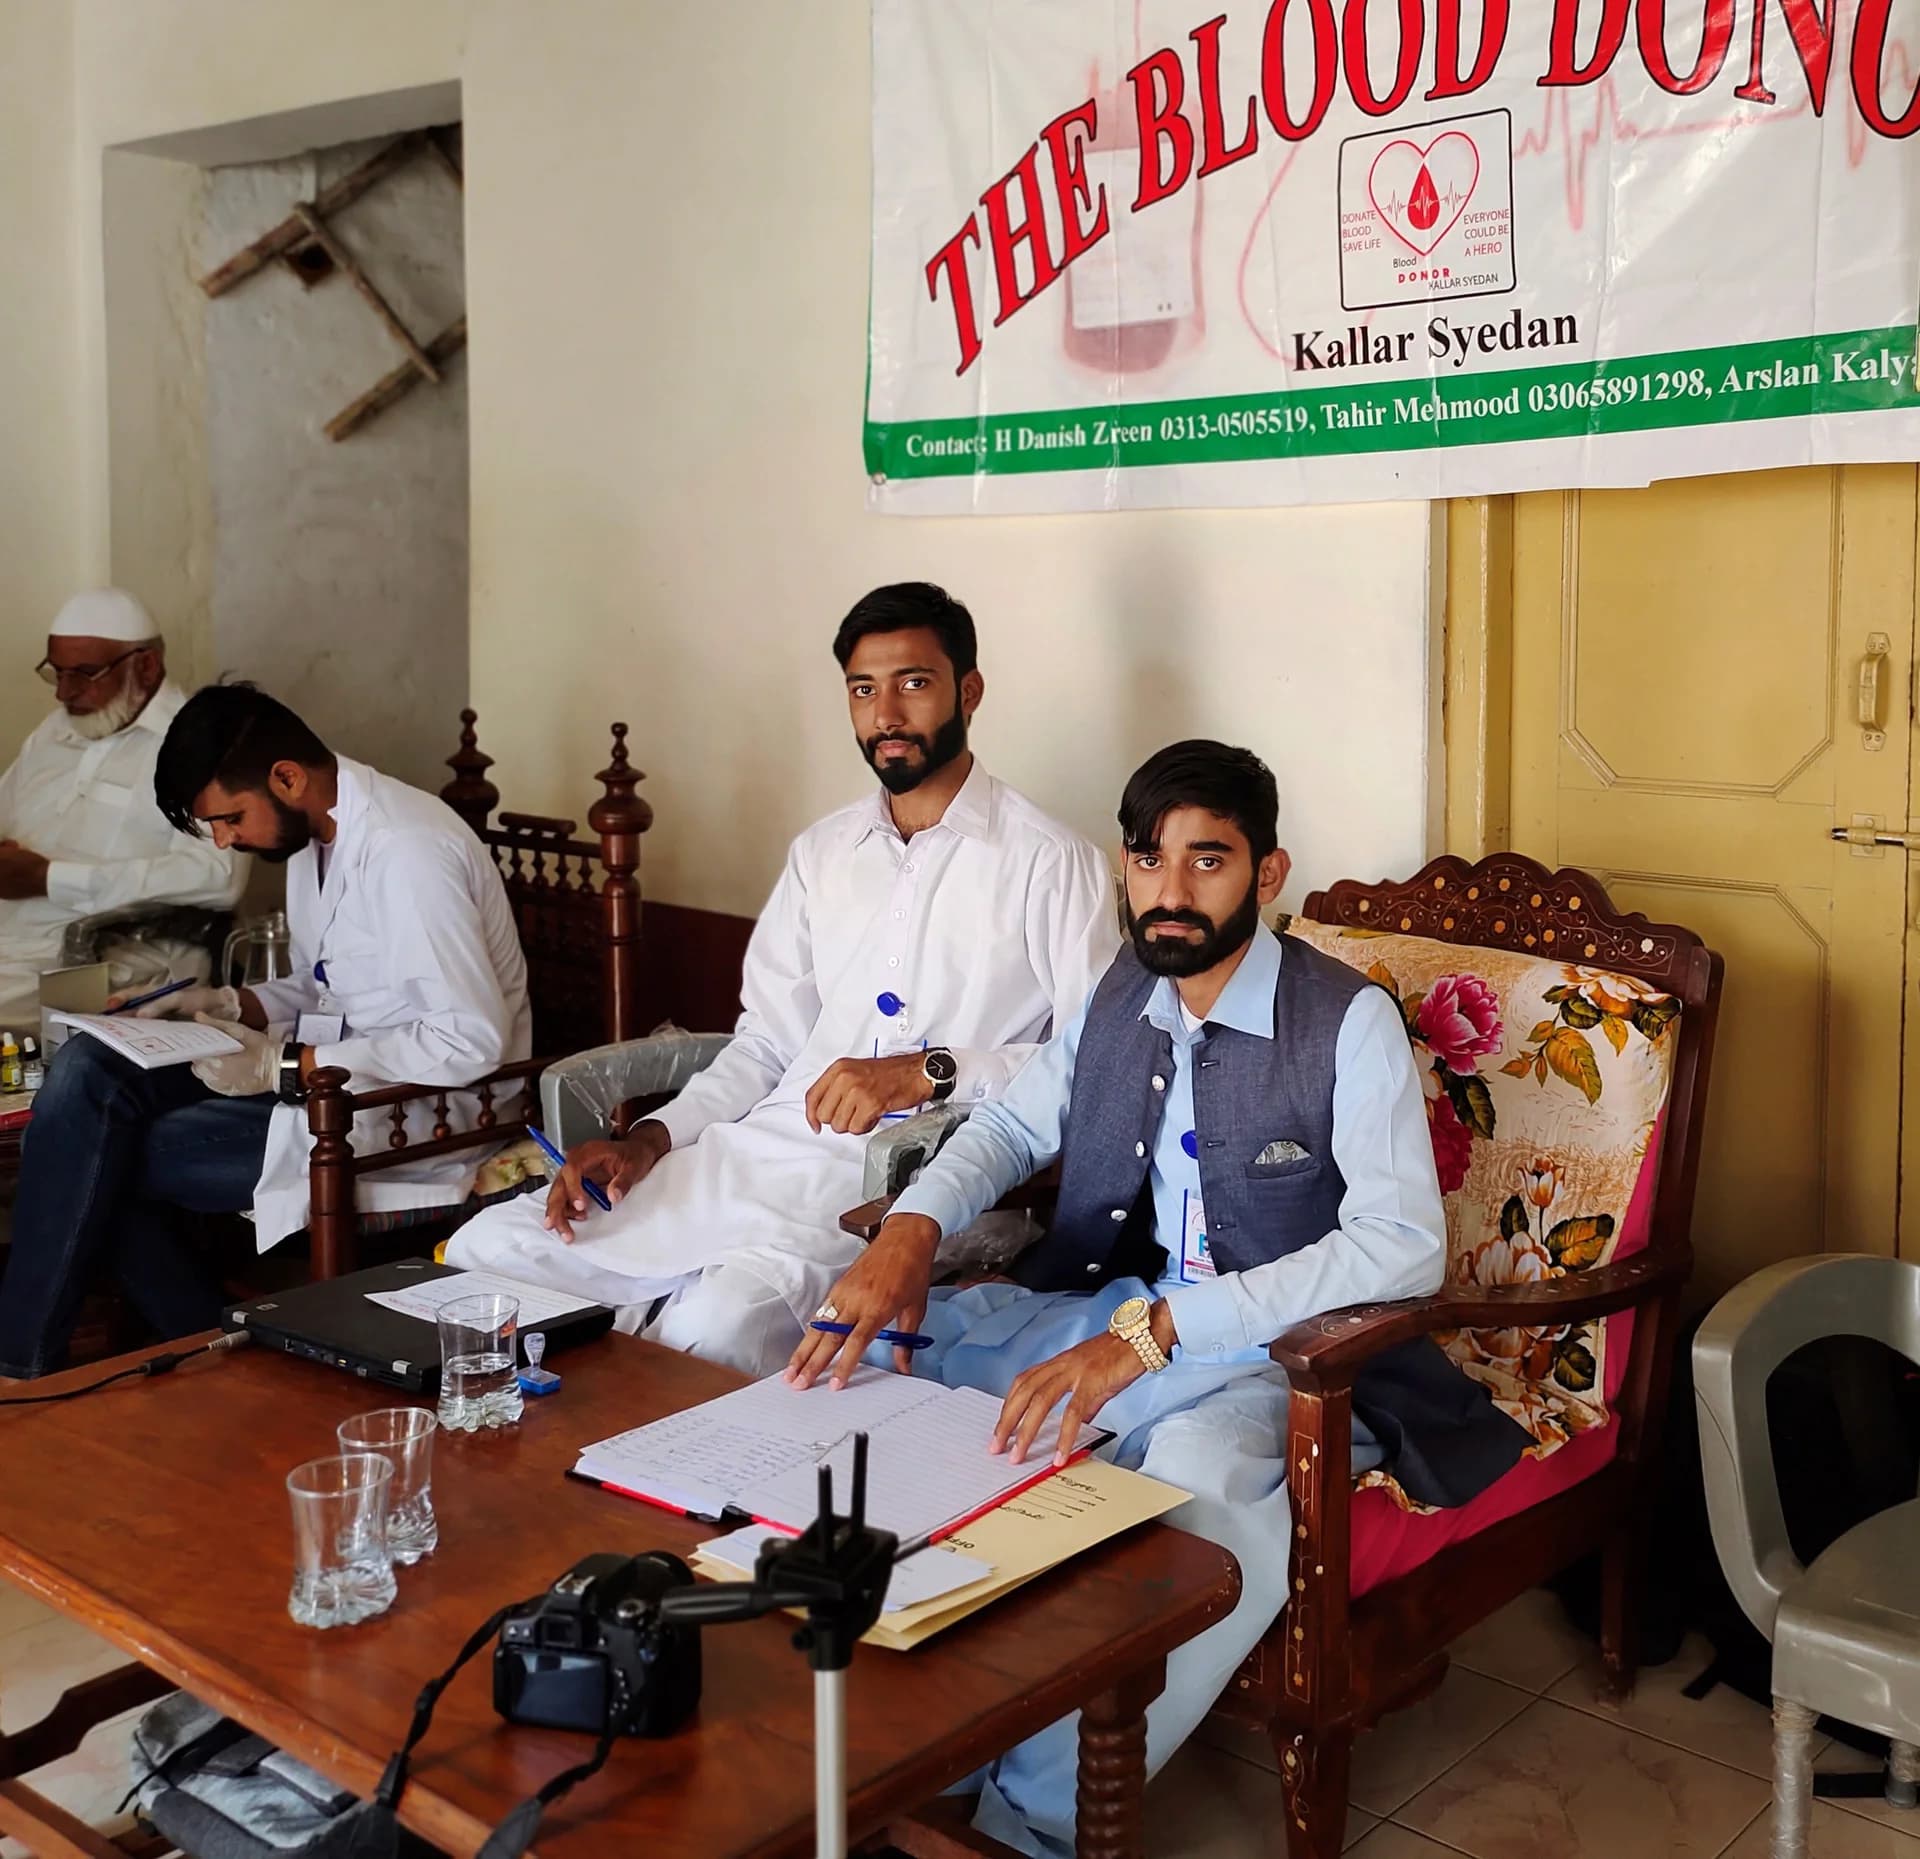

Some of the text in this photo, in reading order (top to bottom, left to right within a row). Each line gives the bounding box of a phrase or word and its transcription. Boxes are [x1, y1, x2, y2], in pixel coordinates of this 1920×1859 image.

[925, 97, 1110, 377] THE
[1126, 0, 1511, 213] BLOOD
[1342, 209, 1377, 225] DONATE
[1463, 208, 1510, 225] EVERYONE
[1342, 225, 1372, 239] BLOOD
[1464, 223, 1510, 240] COULD BE
[1343, 238, 1382, 253] SAVE LIFE
[1464, 241, 1503, 257] A HERO
[1392, 256, 1417, 268] Blood
[1398, 267, 1450, 284] DONOR
[1429, 272, 1499, 291] KALLAR SYEDAN
[1292, 308, 1579, 372] Kallar Syedan
[995, 427, 1012, 453] H
[1017, 423, 1087, 451] Danish
[1159, 406, 1317, 441] 0313-0505519,
[1319, 400, 1388, 430] Tahir
[1392, 387, 1521, 425] Mehmood
[1528, 368, 1713, 413] 03065891298,
[1717, 359, 1821, 394] Arslan
